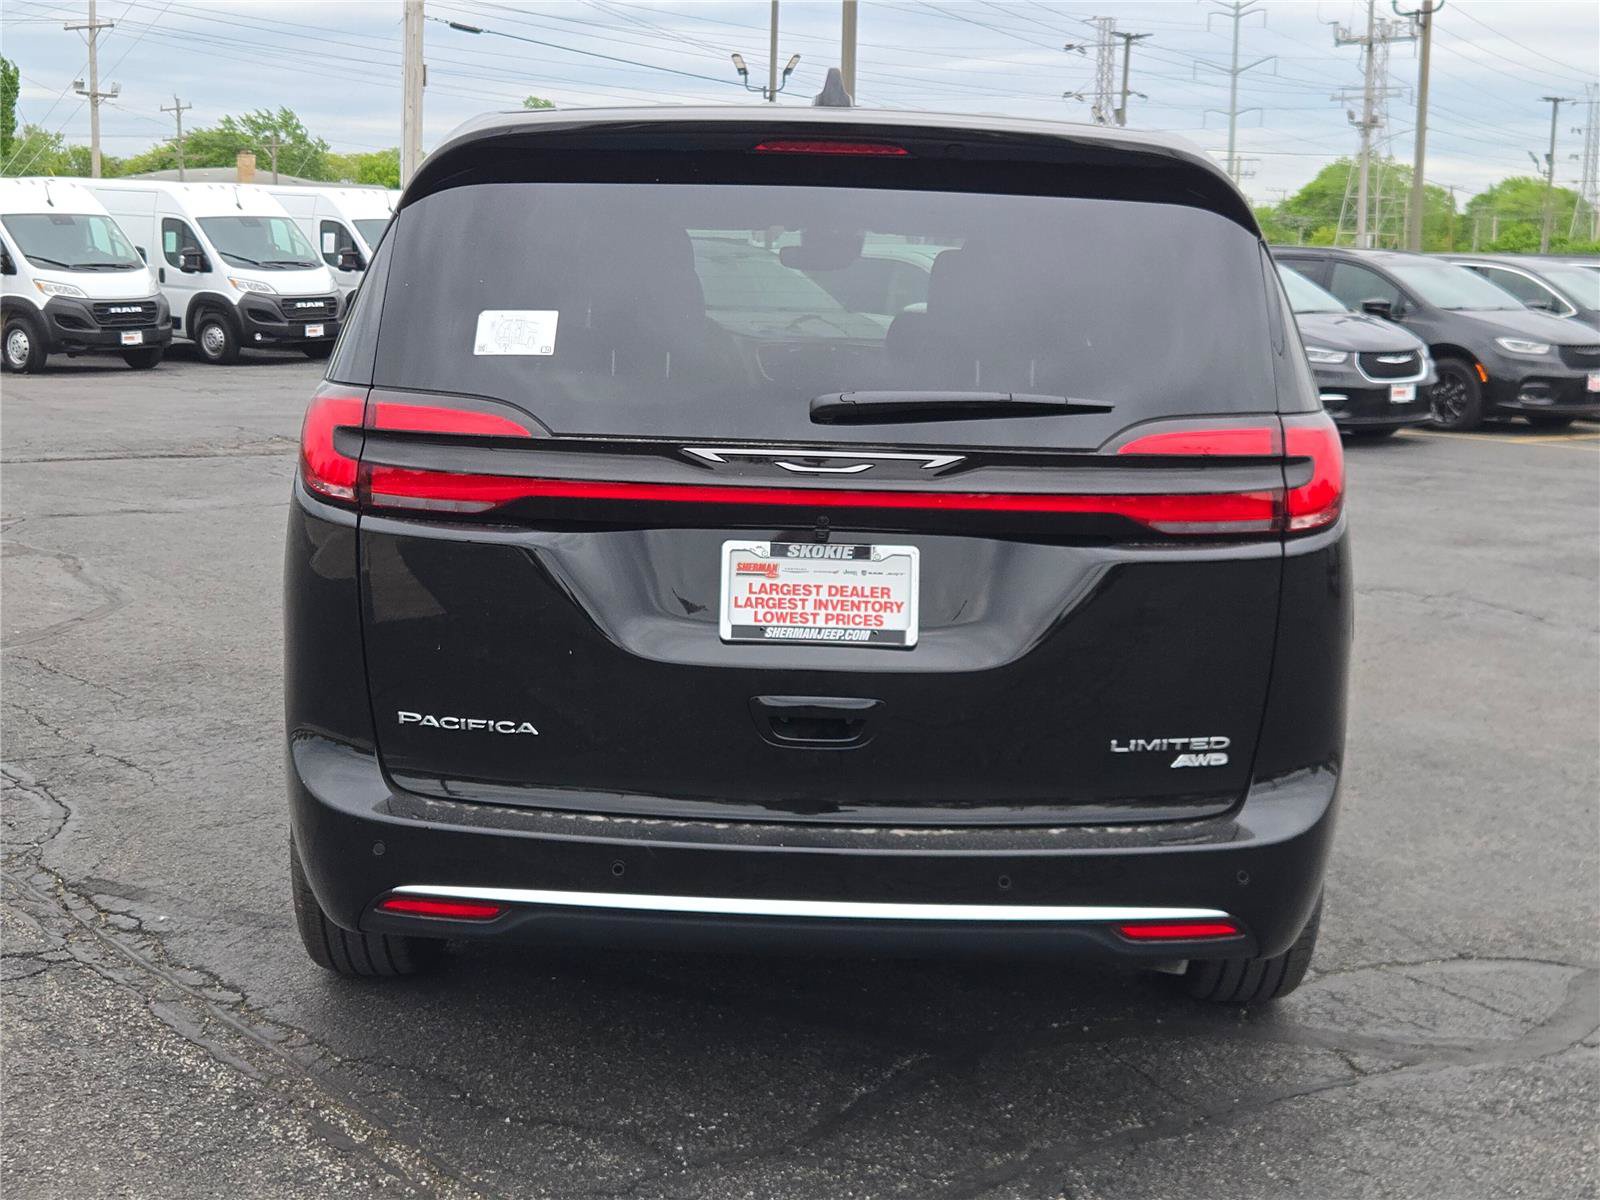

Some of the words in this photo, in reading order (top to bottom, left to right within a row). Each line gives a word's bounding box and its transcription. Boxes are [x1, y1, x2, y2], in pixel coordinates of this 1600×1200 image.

[110, 306, 142, 314] RAM
[787, 544, 855, 560] SKOKIE
[736, 562, 778, 574] SHERMAN
[748, 583, 823, 596] LARGEST
[828, 585, 891, 599] DEALER
[734, 596, 811, 610] LARGEST
[813, 598, 904, 613] INVENTORY
[754, 611, 820, 625] LOWEST
[825, 612, 884, 627] PRICES
[764, 627, 871, 641] SHERMANJEEP.COM
[397, 711, 539, 736] PACIFICA
[1110, 736, 1231, 753] LIMITED
[1170, 752, 1229, 769] AWD
